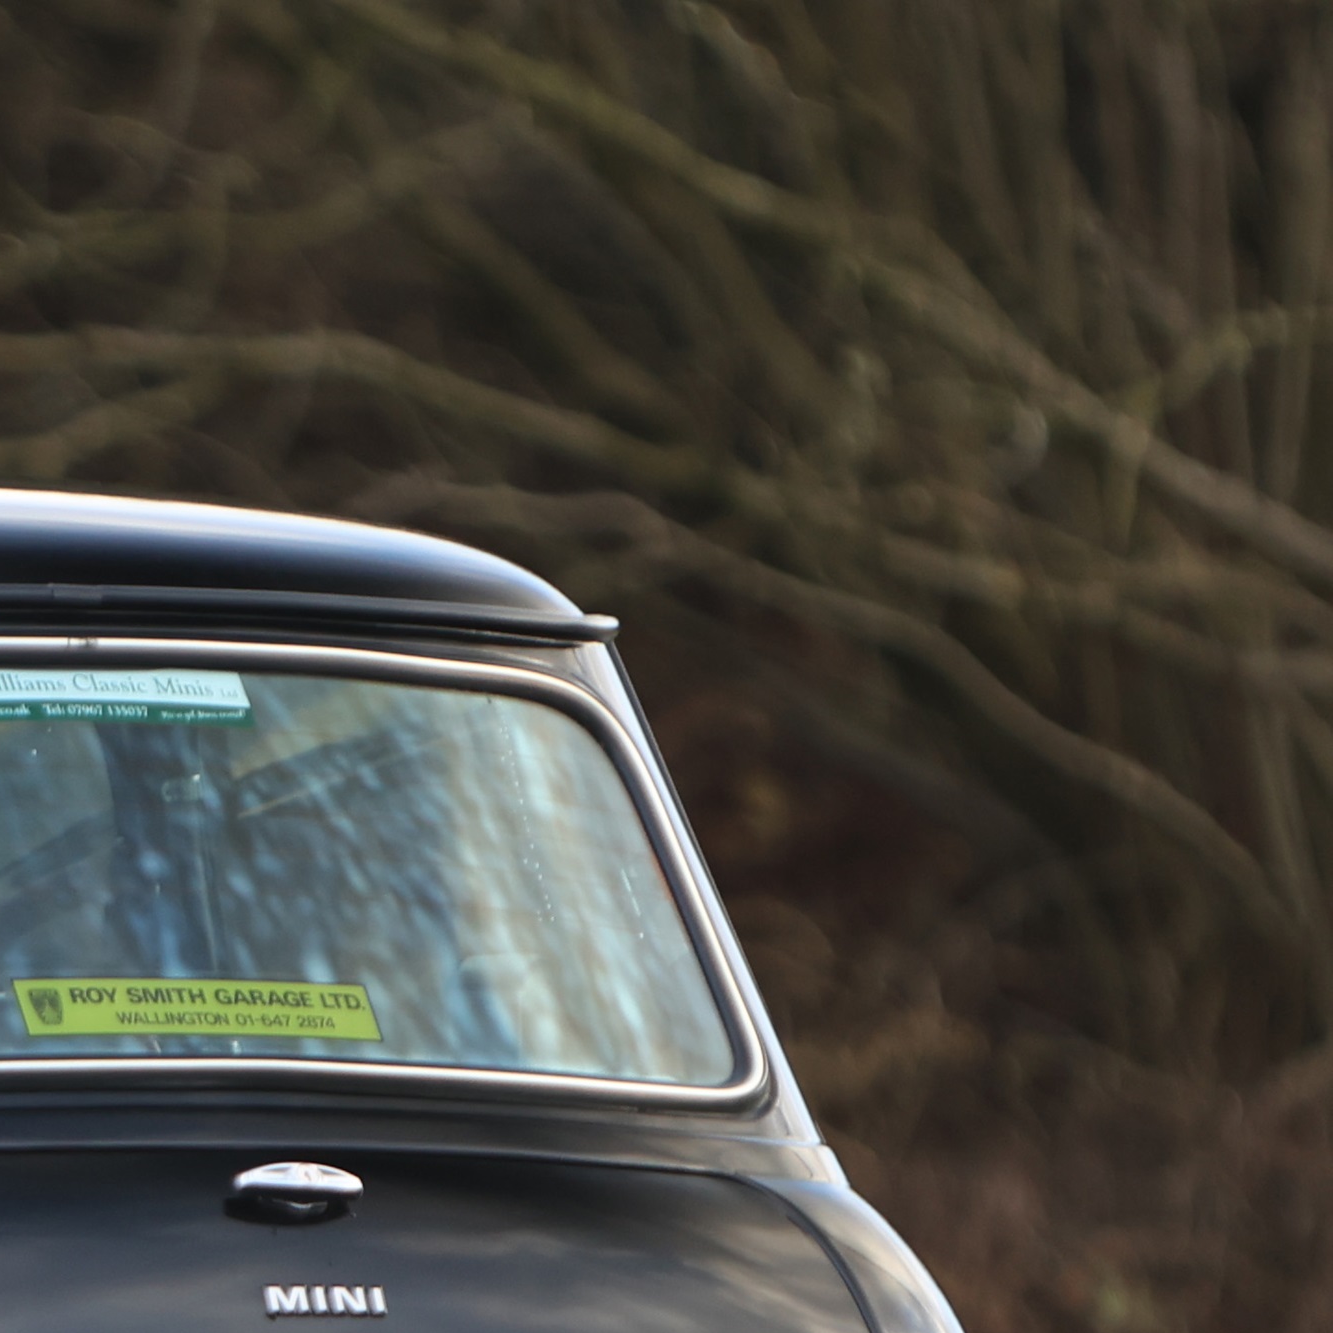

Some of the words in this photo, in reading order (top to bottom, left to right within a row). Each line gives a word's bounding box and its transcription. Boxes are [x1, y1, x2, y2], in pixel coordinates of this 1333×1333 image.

[72, 673, 147, 693] Classic
[152, 675, 214, 697] Minis
[68, 986, 117, 1004] ROY
[125, 987, 207, 1004] SMITH
[214, 988, 314, 1008] GARAGE
[319, 992, 366, 1011] LTD.
[116, 1011, 231, 1026] WALLINGTON
[235, 1013, 291, 1027] 01-647
[296, 1015, 336, 1029] 2874
[263, 1283, 389, 1317] MINI
